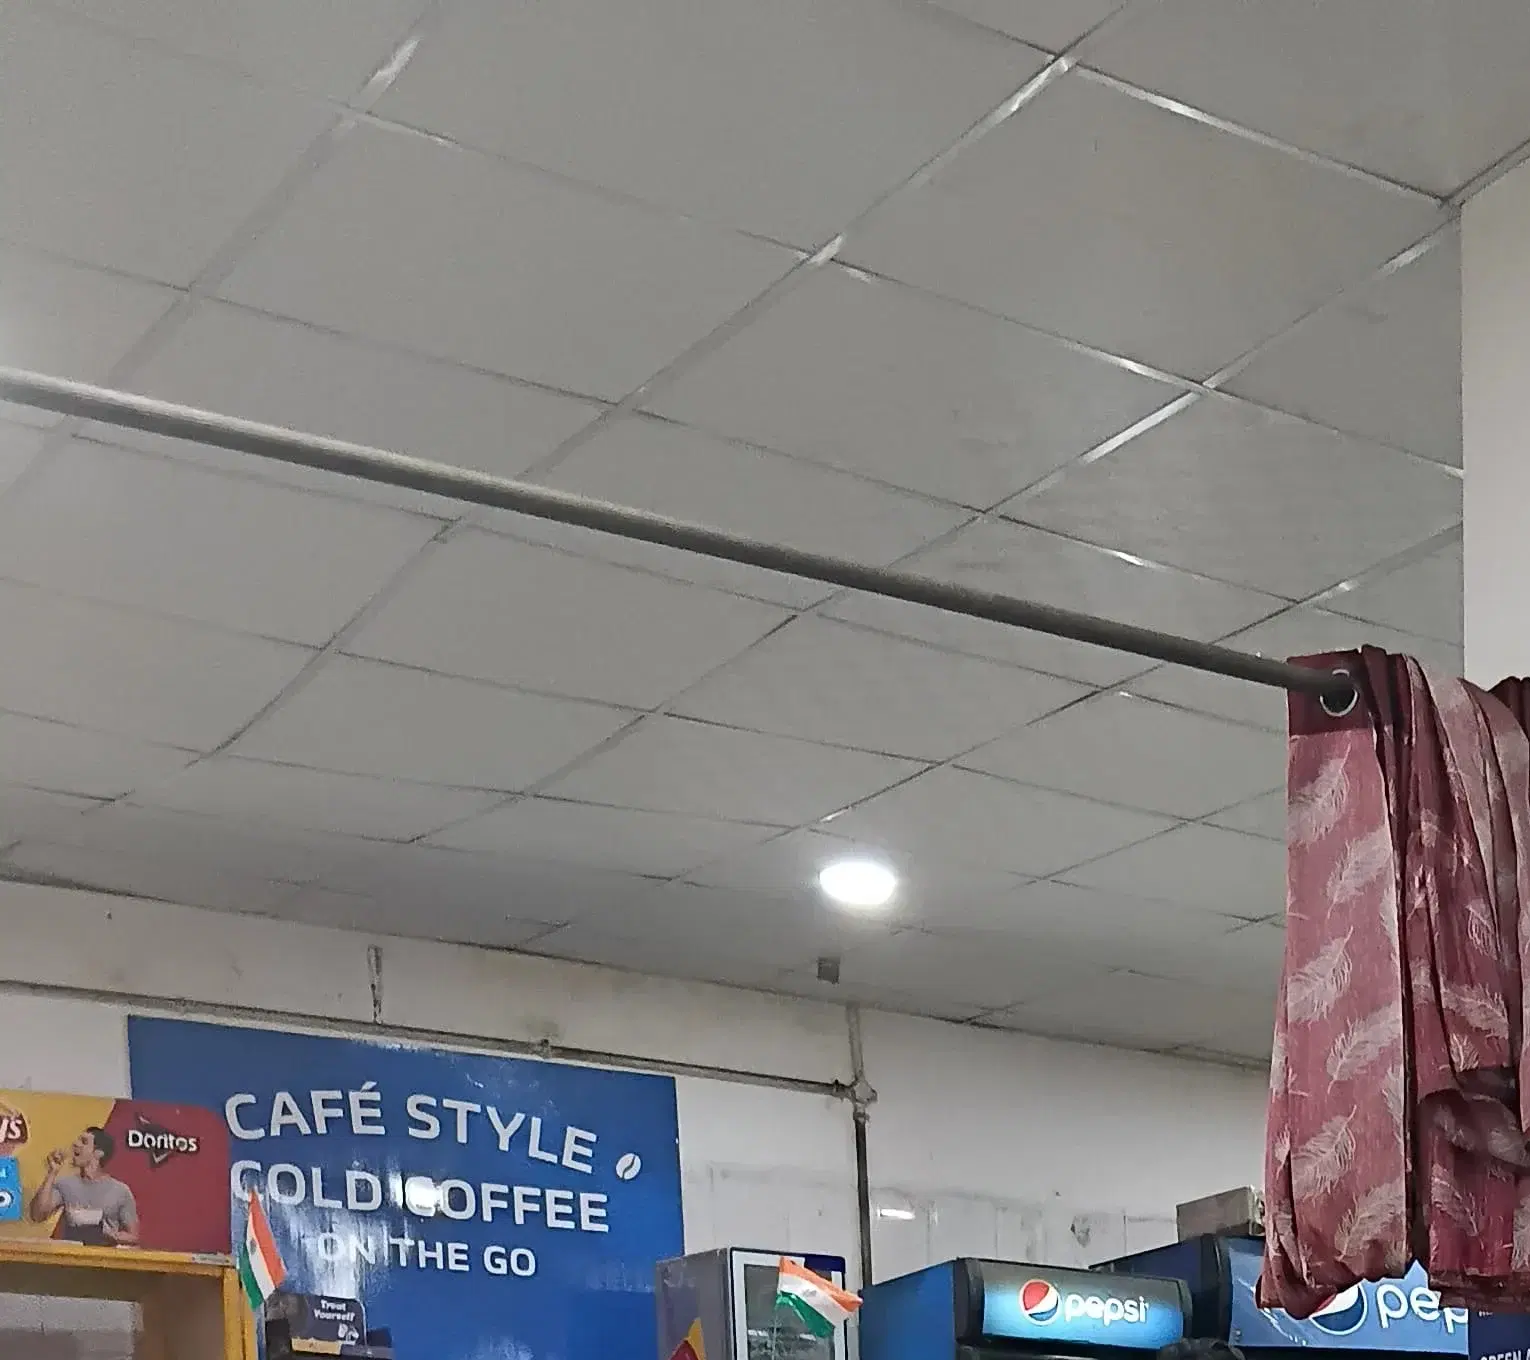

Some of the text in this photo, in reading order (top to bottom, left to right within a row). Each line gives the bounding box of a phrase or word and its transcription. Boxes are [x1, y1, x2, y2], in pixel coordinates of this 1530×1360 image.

[128, 1129, 198, 1152] Doritos
[224, 1080, 598, 1176] CAFÉ STYLE
[230, 1160, 609, 1233] COLD COFFEE
[318, 1232, 536, 1277] ON THE GO
[1065, 1294, 1147, 1326] pepsi
